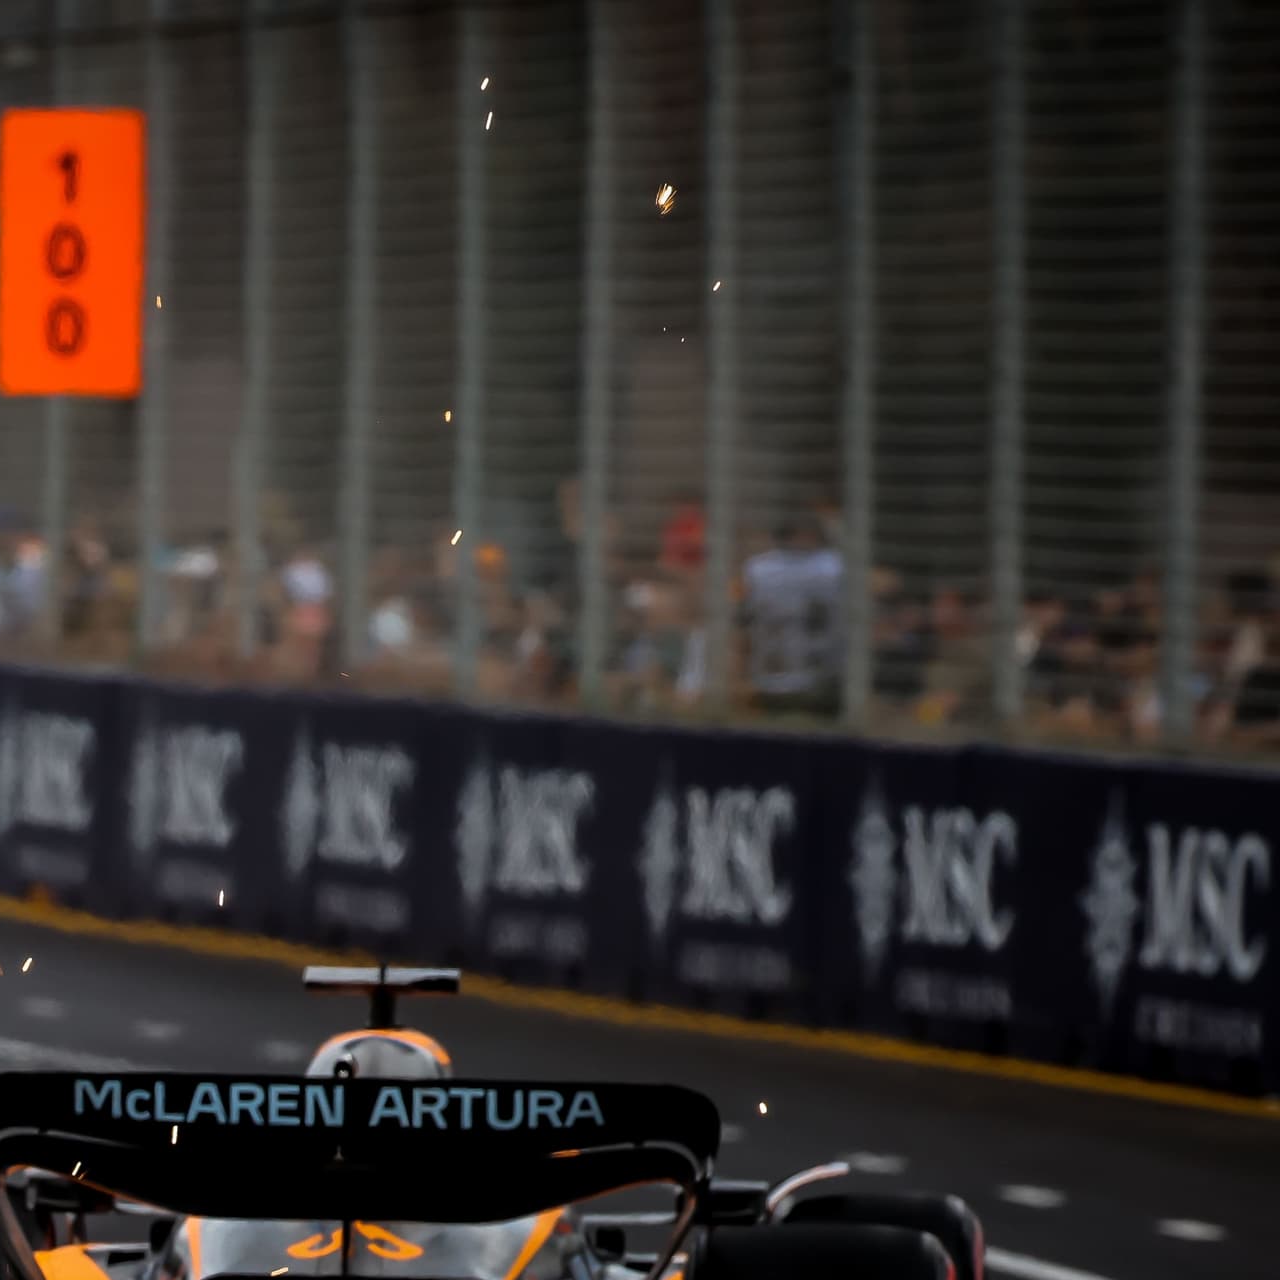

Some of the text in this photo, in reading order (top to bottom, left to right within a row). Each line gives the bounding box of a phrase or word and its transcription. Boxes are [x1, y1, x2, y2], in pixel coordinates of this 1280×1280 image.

[44, 151, 88, 358] 100
[683, 785, 795, 924] MSC
[902, 806, 1017, 951] MSC
[1141, 823, 1270, 981] MSC
[74, 1079, 605, 1129] McLAREN ARTURA
